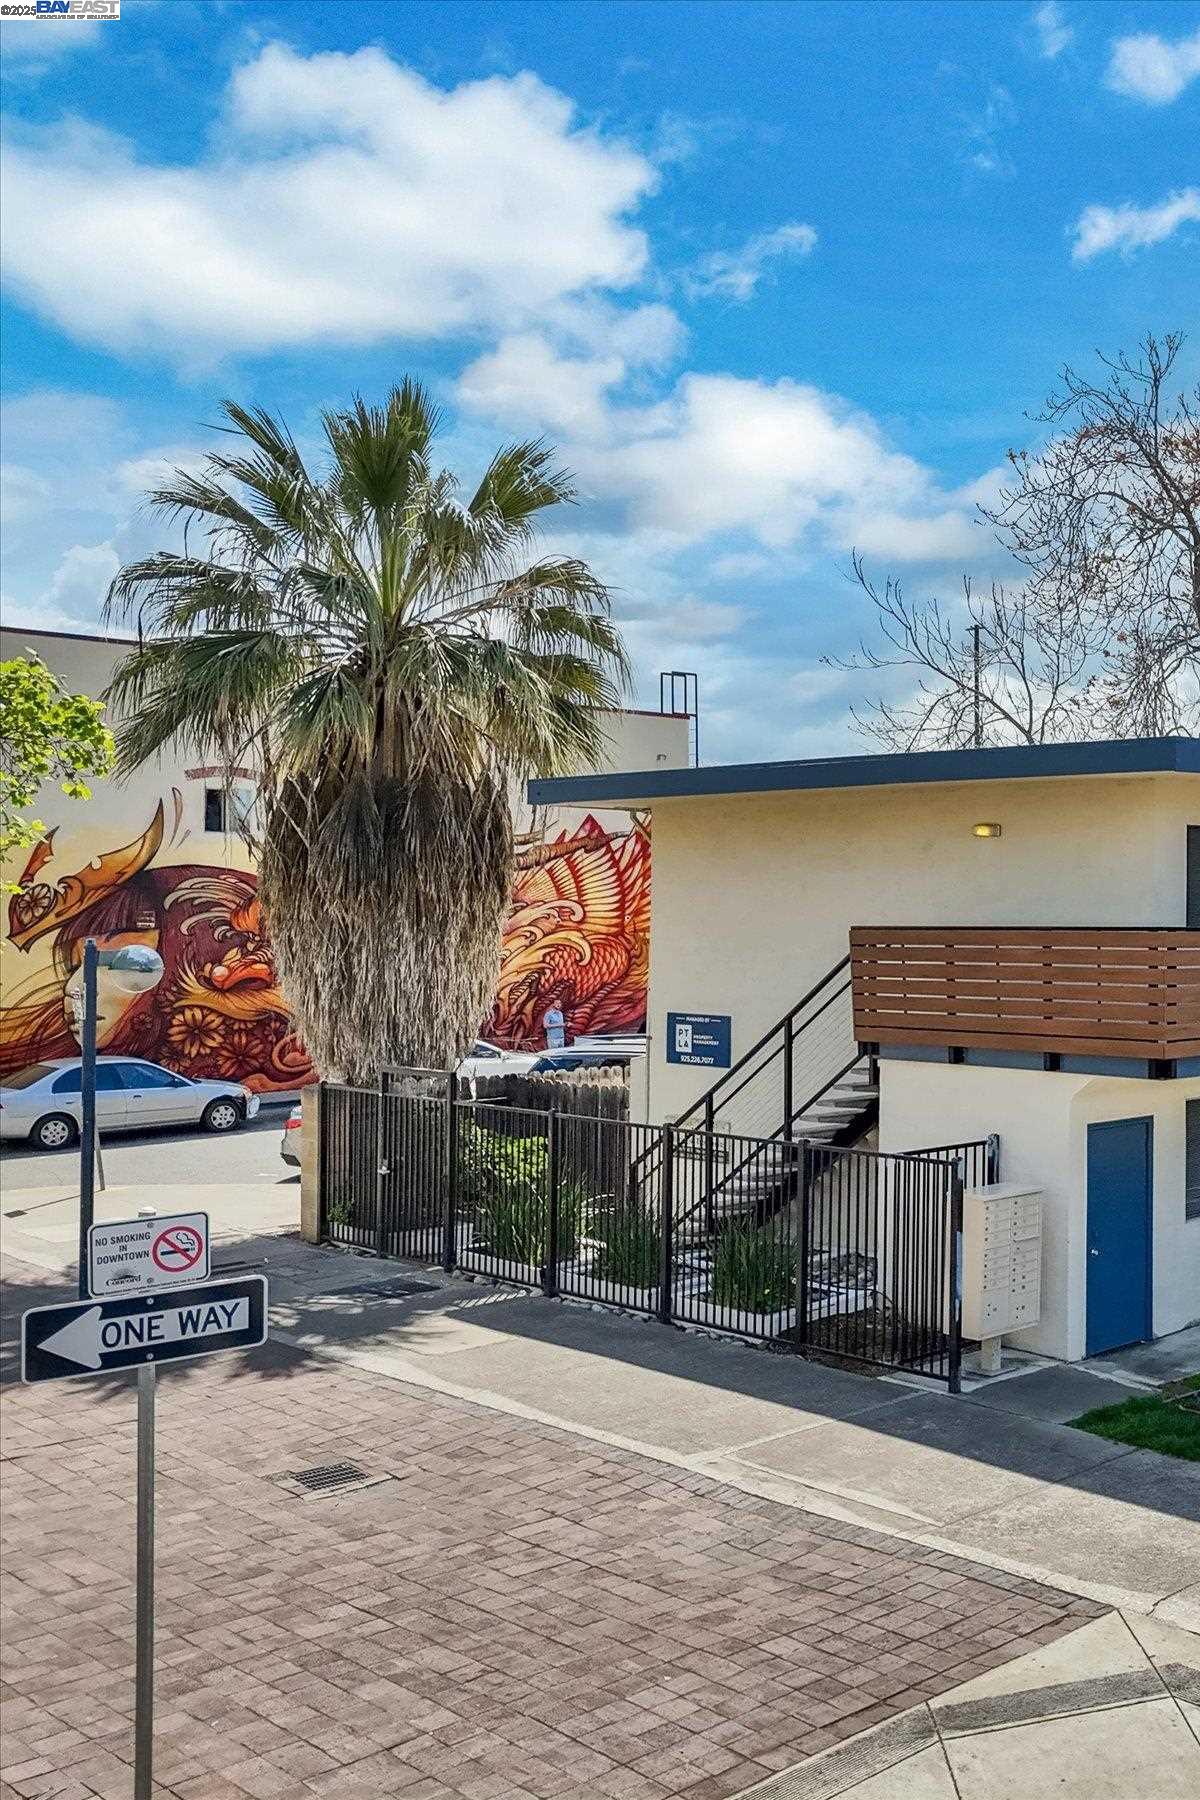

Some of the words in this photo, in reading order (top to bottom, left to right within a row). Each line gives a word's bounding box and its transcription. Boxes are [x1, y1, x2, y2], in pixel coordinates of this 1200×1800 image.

[95, 1237, 108, 1247] NO
[110, 1231, 151, 1245] SMOKING
[118, 1244, 128, 1252] IN
[96, 1250, 150, 1265] DOWNTOWN
[101, 1314, 164, 1348] ONE
[178, 1302, 241, 1336] WAY
